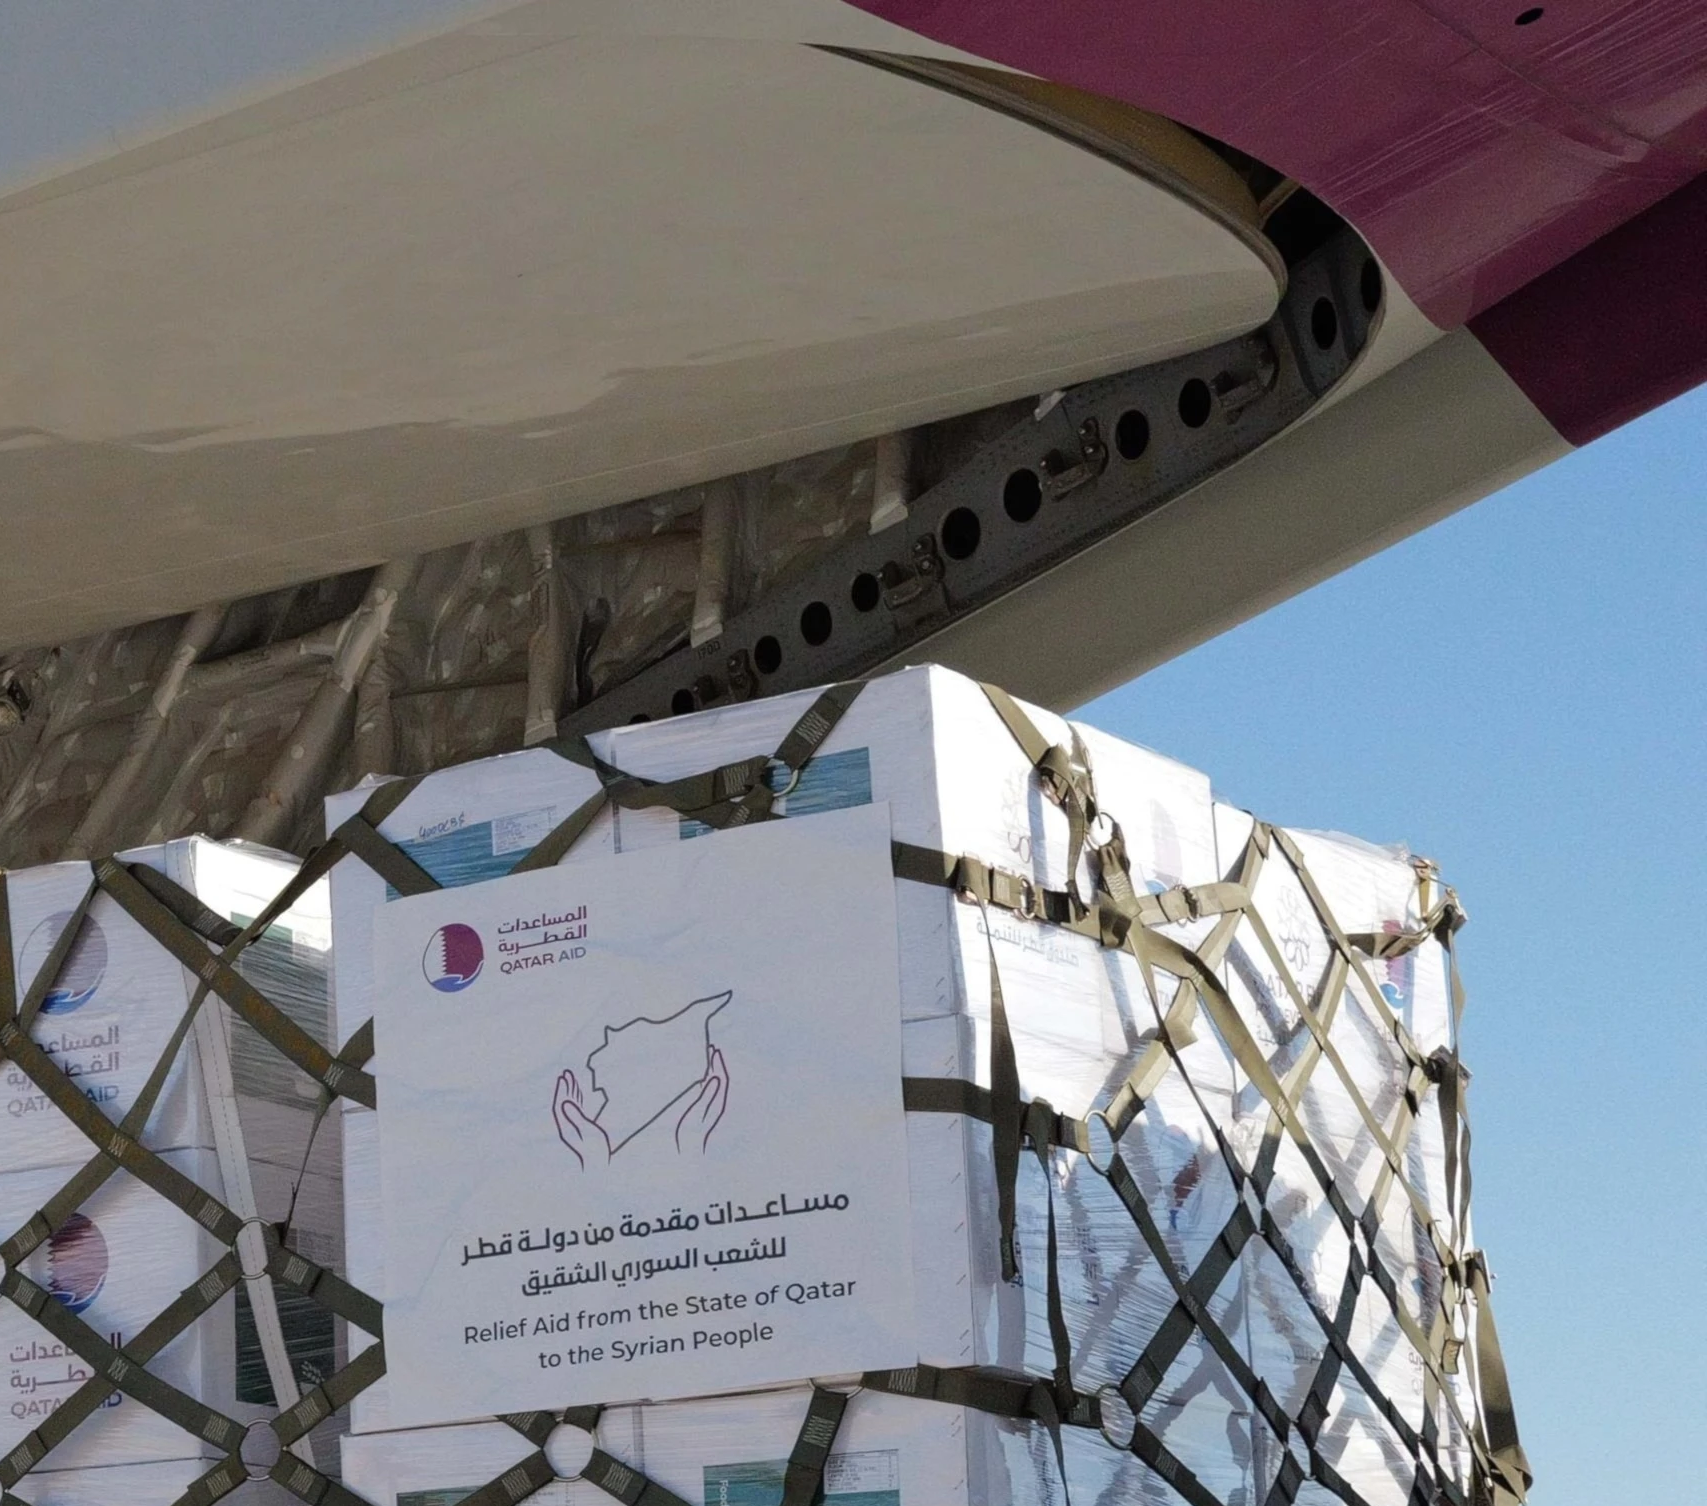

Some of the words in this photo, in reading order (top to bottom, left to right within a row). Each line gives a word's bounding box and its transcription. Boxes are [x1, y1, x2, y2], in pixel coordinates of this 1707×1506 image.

[498, 905, 587, 934] المساعدات
[498, 924, 587, 956] القطرية
[500, 953, 554, 975] QATAR
[558, 946, 587, 963] AID
[35, 1026, 119, 1054] المساعد
[620, 1208, 699, 1237] مقدمة
[705, 1193, 849, 1225] مساعدات
[461, 1232, 512, 1266] قطر
[517, 1227, 579, 1254] دولة
[585, 1223, 614, 1246] من
[611, 1248, 697, 1288] السوري
[704, 1236, 786, 1272] للشعب
[521, 1260, 606, 1296] الشقيق
[464, 1318, 527, 1345] Relief
[533, 1311, 570, 1337] Aid
[577, 1305, 631, 1331] from
[637, 1298, 679, 1322] the
[685, 1291, 747, 1315] State
[755, 1284, 780, 1308] of
[785, 1277, 856, 1304] Qatar
[538, 1349, 562, 1370] to
[568, 1343, 604, 1366] the
[611, 1333, 685, 1366] Syrian
[693, 1320, 774, 1354] People
